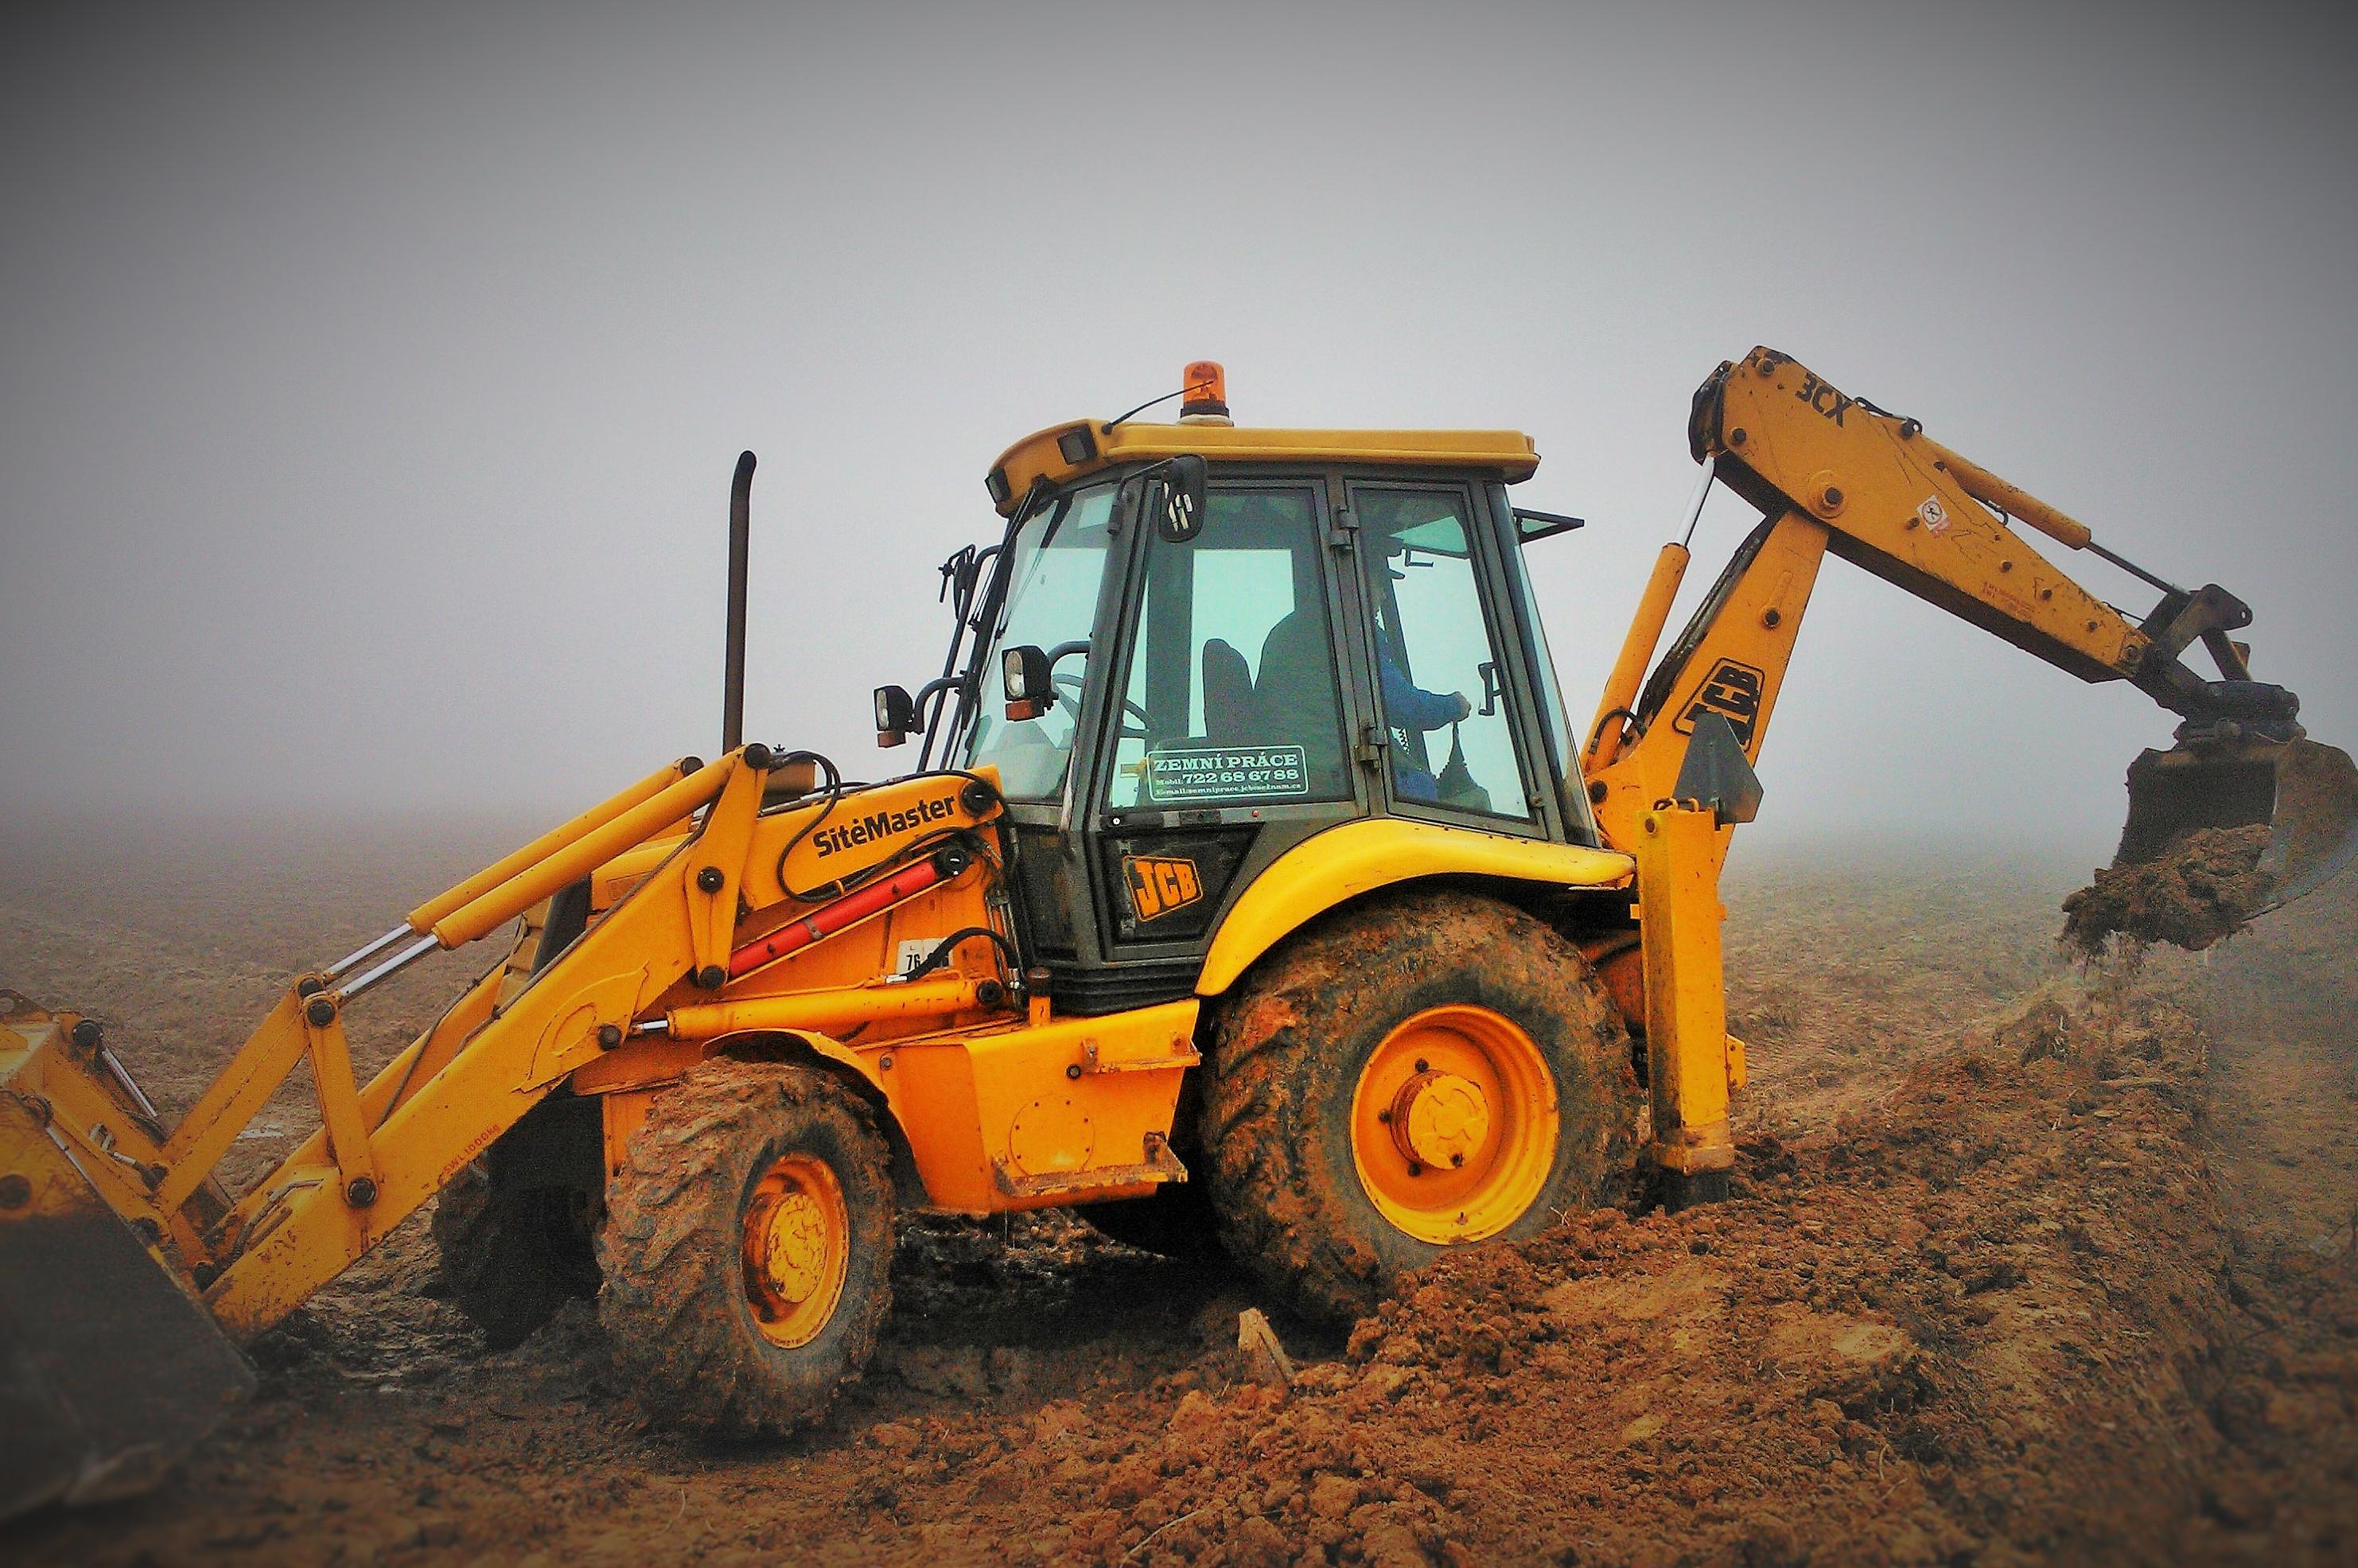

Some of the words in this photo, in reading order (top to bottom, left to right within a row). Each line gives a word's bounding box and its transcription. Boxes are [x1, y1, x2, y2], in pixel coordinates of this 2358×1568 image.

[1795, 372, 1853, 428] 3CX
[1154, 753, 1224, 772] ZEMNÍ
[1226, 752, 1298, 768] PRÁCE
[1182, 772, 1218, 784] 722
[1220, 772, 1246, 783] 68
[1248, 770, 1271, 781] 67
[1273, 769, 1299, 780] 88
[812, 796, 955, 858] SiteMaster
[1134, 861, 1197, 916] JCB
